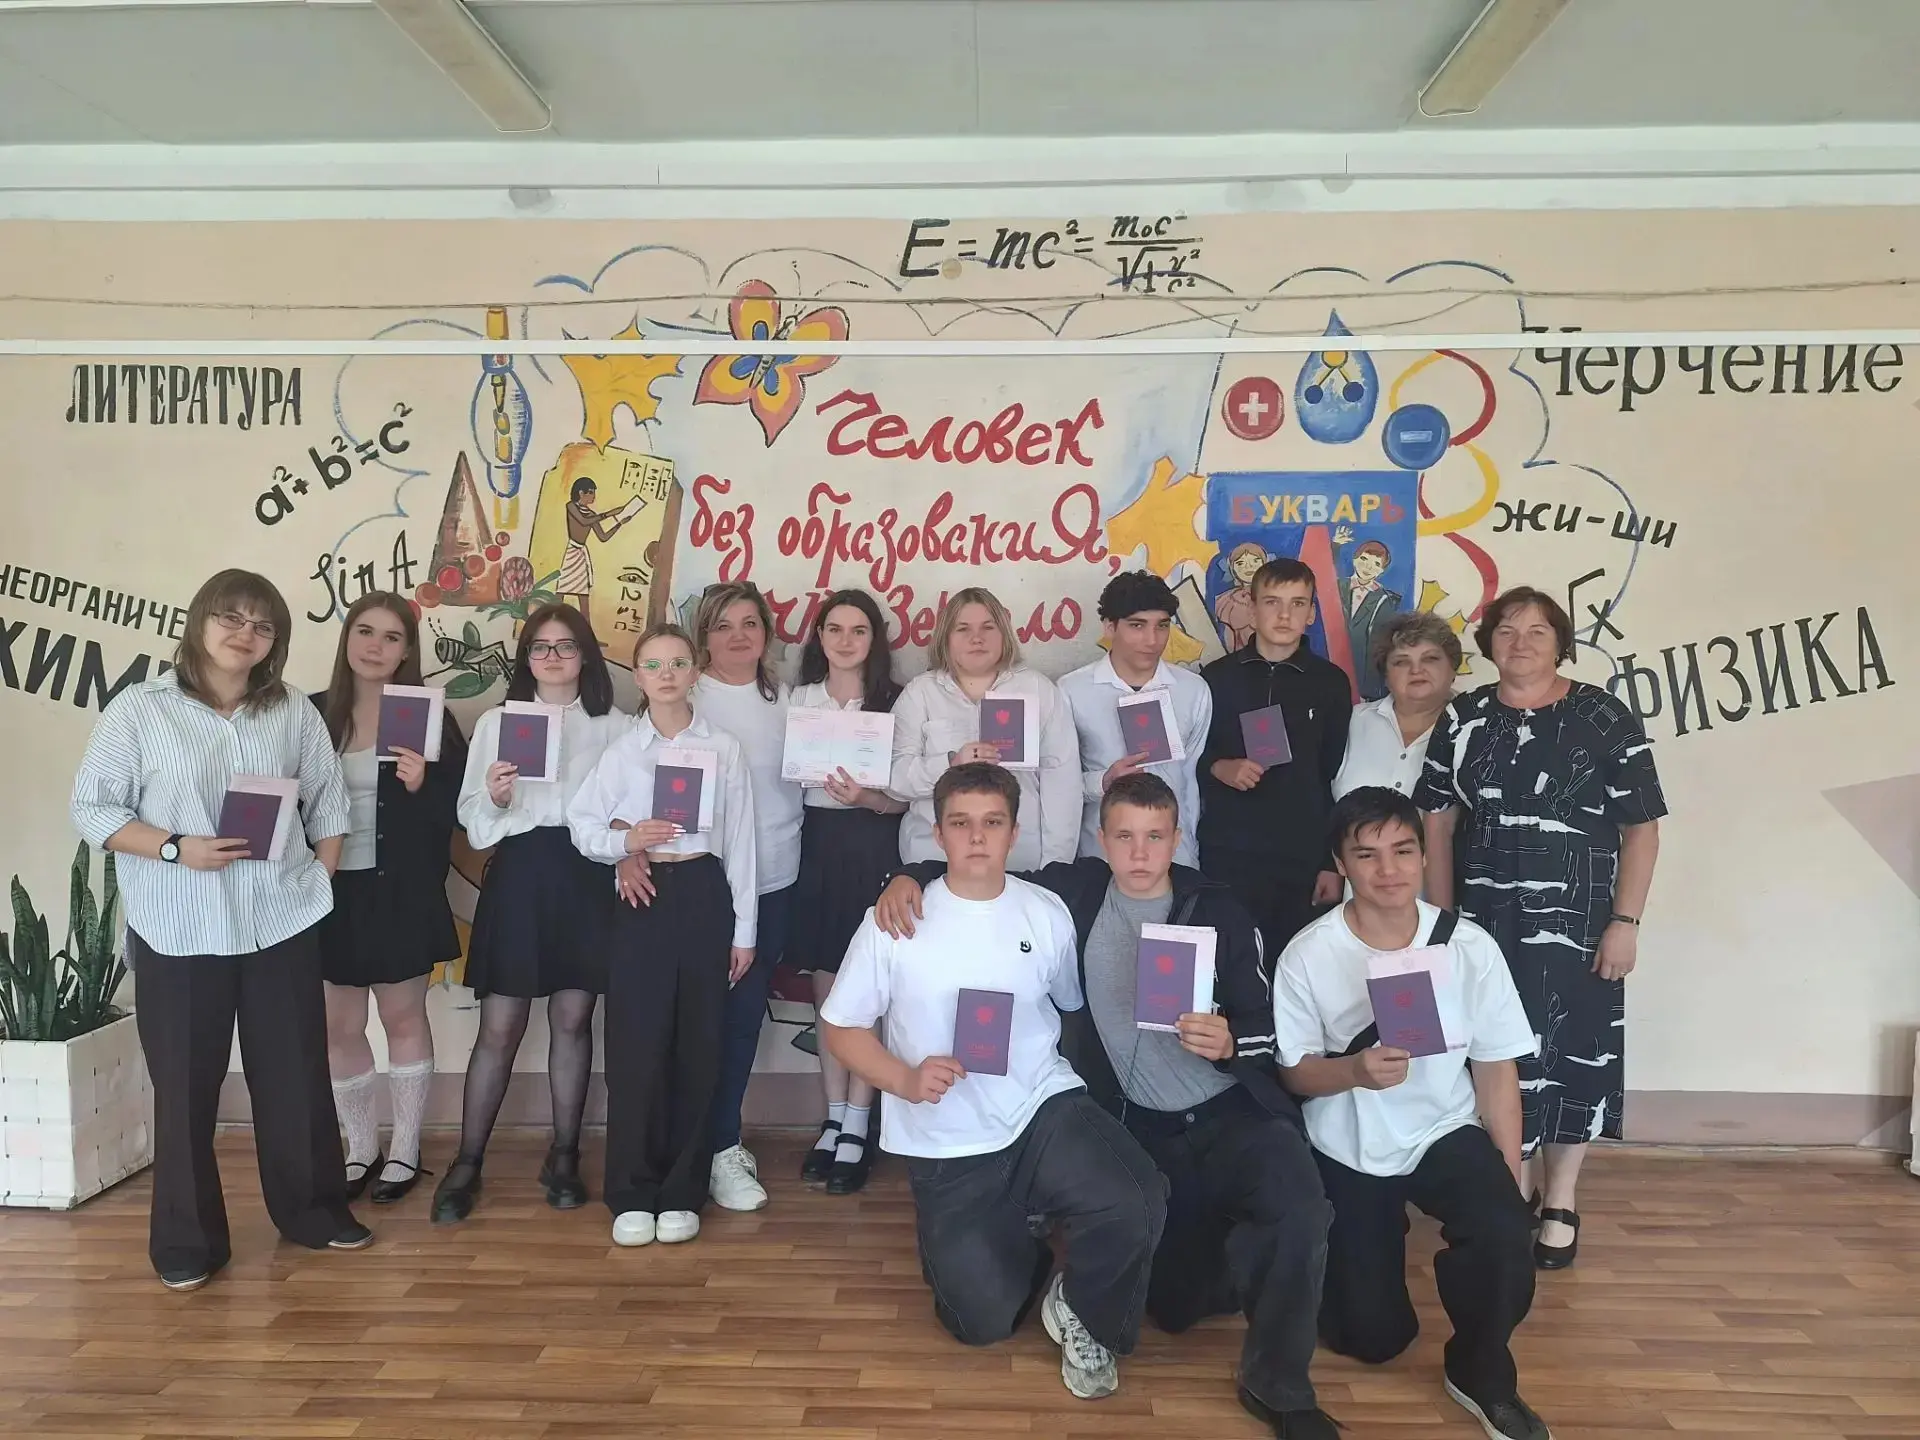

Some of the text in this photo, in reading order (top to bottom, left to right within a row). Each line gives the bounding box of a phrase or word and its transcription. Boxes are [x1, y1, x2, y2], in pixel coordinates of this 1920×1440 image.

[66, 364, 302, 430] ЛИТЕРАТУРА
[1522, 327, 1903, 411] Черчение
[815, 388, 1104, 467] Человек
[689, 474, 754, 583] без
[1230, 494, 1405, 524] БУКВАРЬ
[0, 617, 173, 712] ХИМ
[1606, 606, 1895, 743] ФИЗИКА
